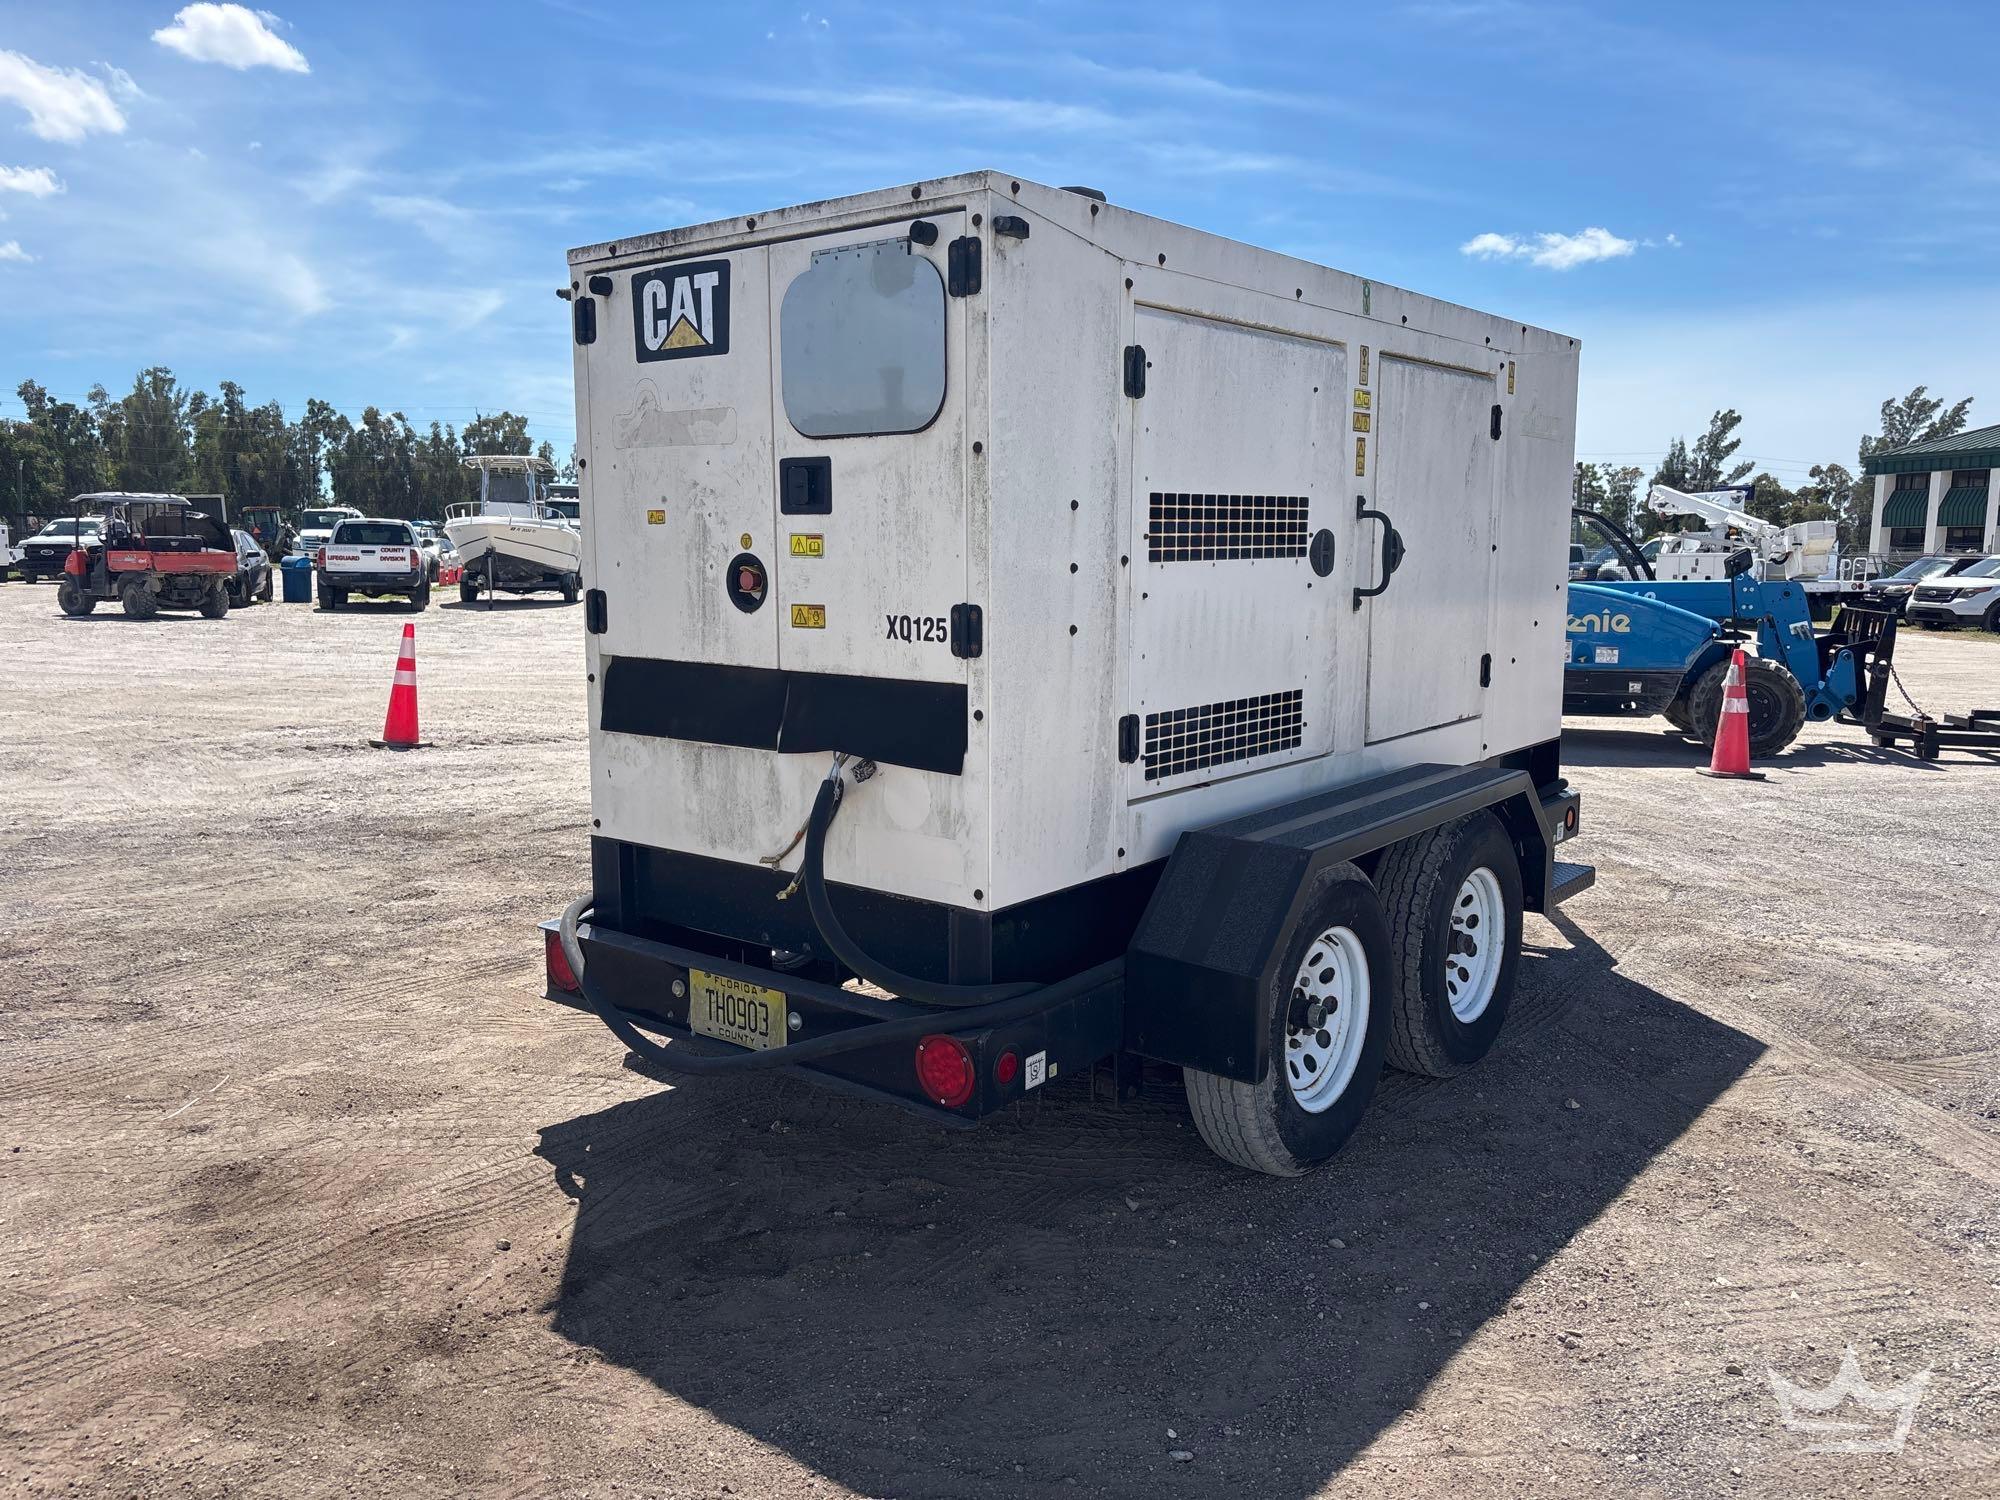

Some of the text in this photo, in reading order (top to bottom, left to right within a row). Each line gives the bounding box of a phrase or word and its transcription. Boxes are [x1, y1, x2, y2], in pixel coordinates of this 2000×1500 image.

[643, 271, 719, 351] CAT
[886, 614, 948, 644] XQ125
[1566, 608, 1631, 633] enie
[714, 976, 758, 995] FLORIDA
[705, 988, 769, 1037] TH0903
[718, 1027, 755, 1045] COUNTY
